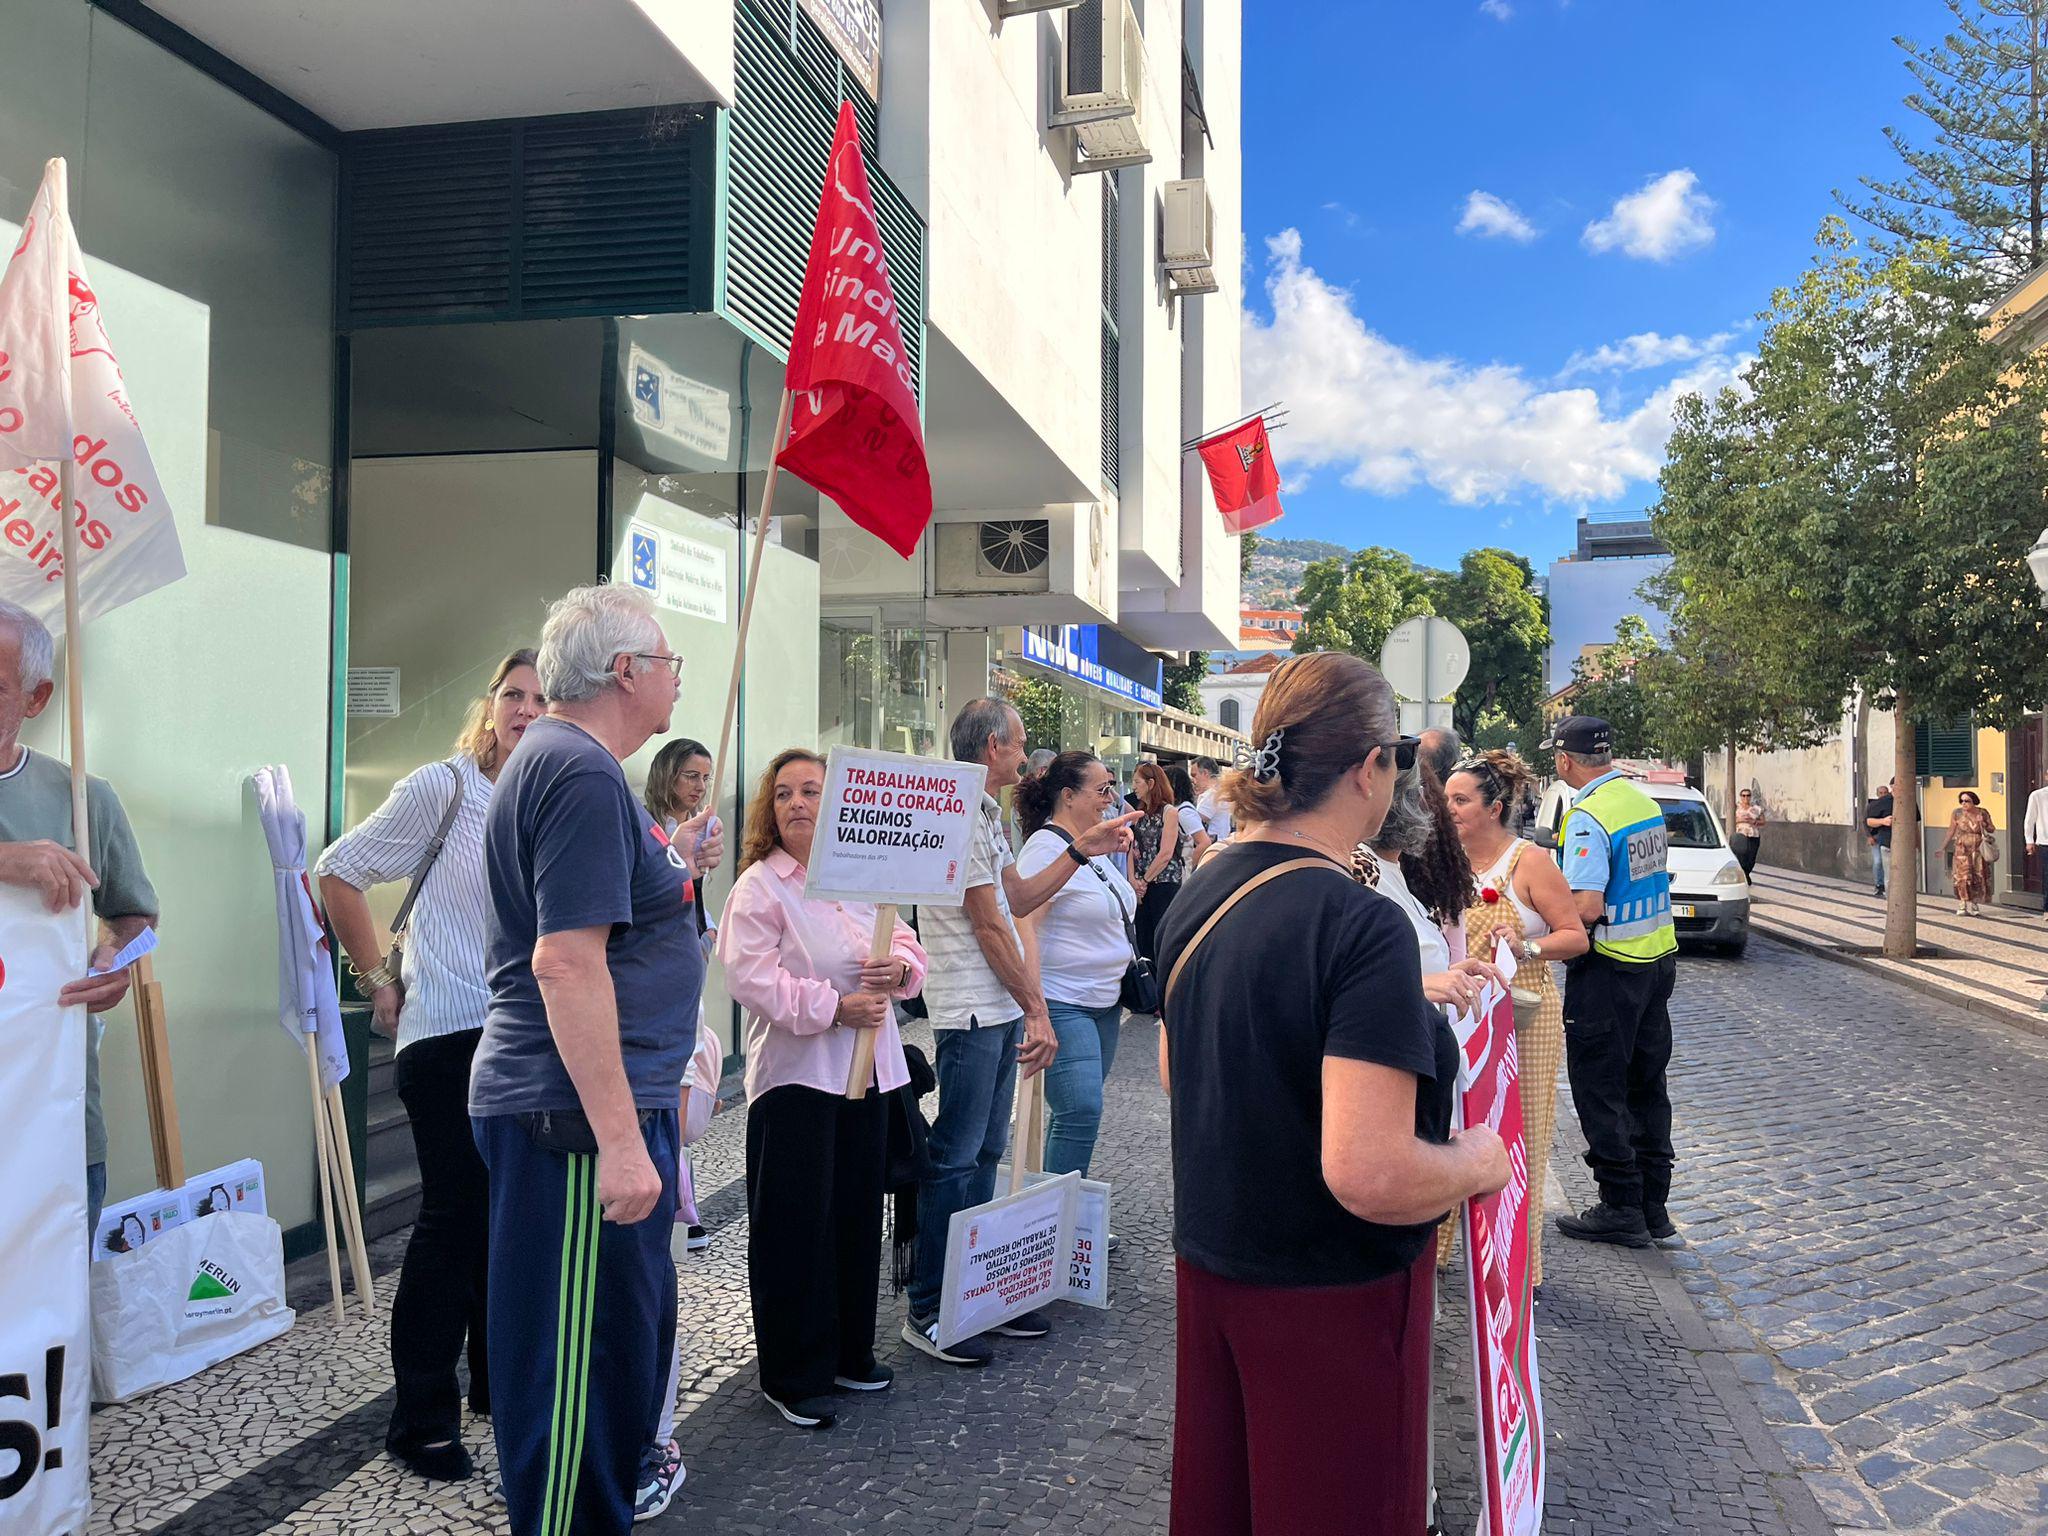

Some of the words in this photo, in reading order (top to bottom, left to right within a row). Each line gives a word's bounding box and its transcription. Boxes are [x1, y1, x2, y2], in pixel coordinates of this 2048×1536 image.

[73, 434, 148, 513] dos
[847, 768, 957, 794] TRABALHAMOS
[843, 788, 876, 806] COM
[881, 791, 893, 807] O
[897, 793, 966, 817] CORAÇÃO,
[839, 807, 913, 828] EXIGIMOS
[837, 826, 945, 852] VALORIZAÇÃO!
[1050, 1224, 1057, 1233] DE
[1012, 1228, 1048, 1249] TRABALHO
[1022, 1236, 1056, 1256] CONTRATO
[1077, 1239, 1092, 1249] DE
[970, 1243, 1011, 1265] REGIONAL!
[986, 1252, 1020, 1271] COLETIVO
[1020, 1246, 1054, 1265] QUEREMOS
[1039, 1257, 1053, 1270] MAS
[1072, 1250, 1091, 1264] TÉC
[986, 1265, 1011, 1281] NOSSO
[1012, 1263, 1018, 1272] O
[1022, 1263, 1037, 1277] NÃO
[1038, 1269, 1052, 1281] SÃO
[1084, 1267, 1091, 1276] A
[997, 1270, 1021, 1288] PAGAM
[997, 1276, 1037, 1298] MERECIDOS,
[1041, 1280, 1051, 1290] OS
[963, 1282, 995, 1301] CONTAS!
[1005, 1284, 1040, 1306] APLAUSOS
